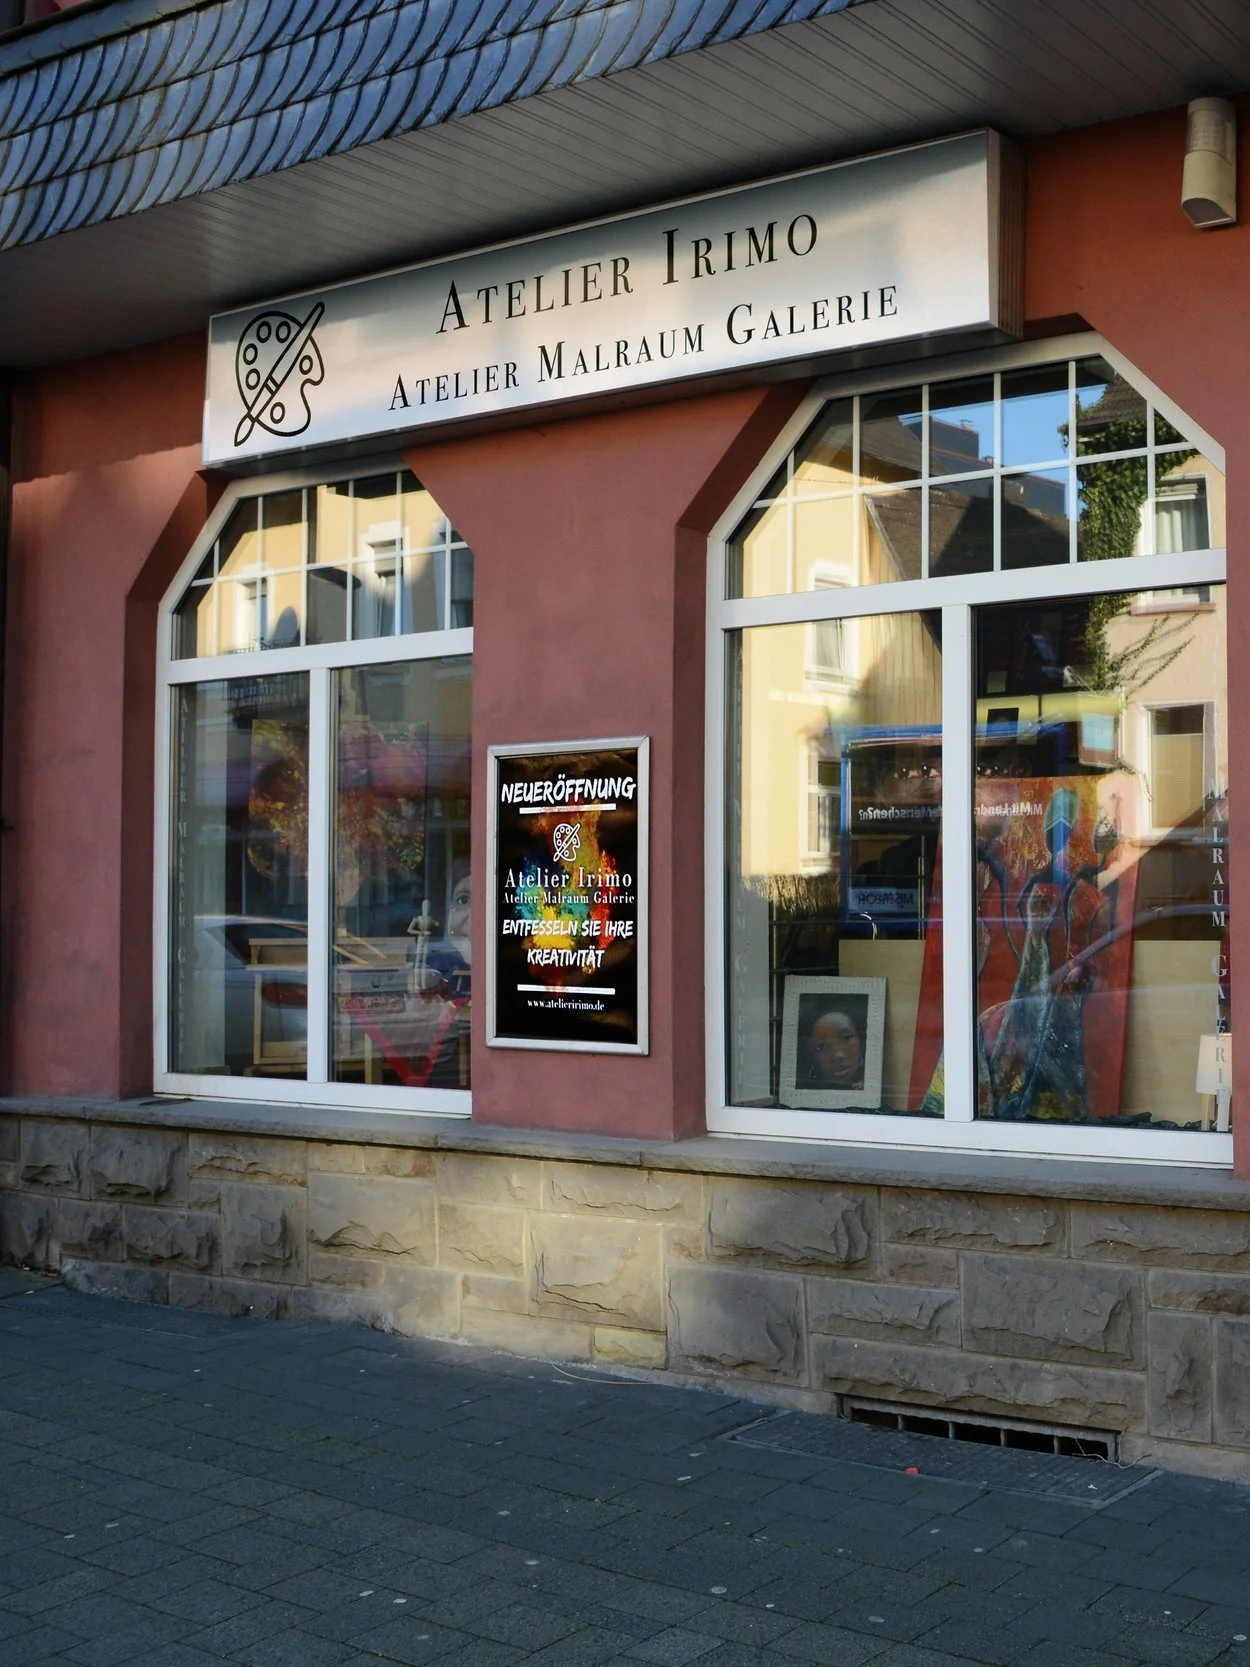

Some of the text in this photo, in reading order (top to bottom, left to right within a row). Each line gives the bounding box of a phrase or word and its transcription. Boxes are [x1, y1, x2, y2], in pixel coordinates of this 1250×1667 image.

[436, 213, 818, 334] ATELIER IRIMO
[388, 284, 899, 411] ATELIER MALRAUM GALERIE
[501, 773, 637, 804] NEUERÖFFNUNG
[505, 866, 632, 888] Atelier Irimo
[503, 891, 635, 904] Atelier Malraum Galerie
[502, 919, 633, 939] ENTFESSELN SIE IHRE
[527, 945, 605, 968] KREATIVITÄT
[527, 998, 605, 1011] www.atelieririmo.de
